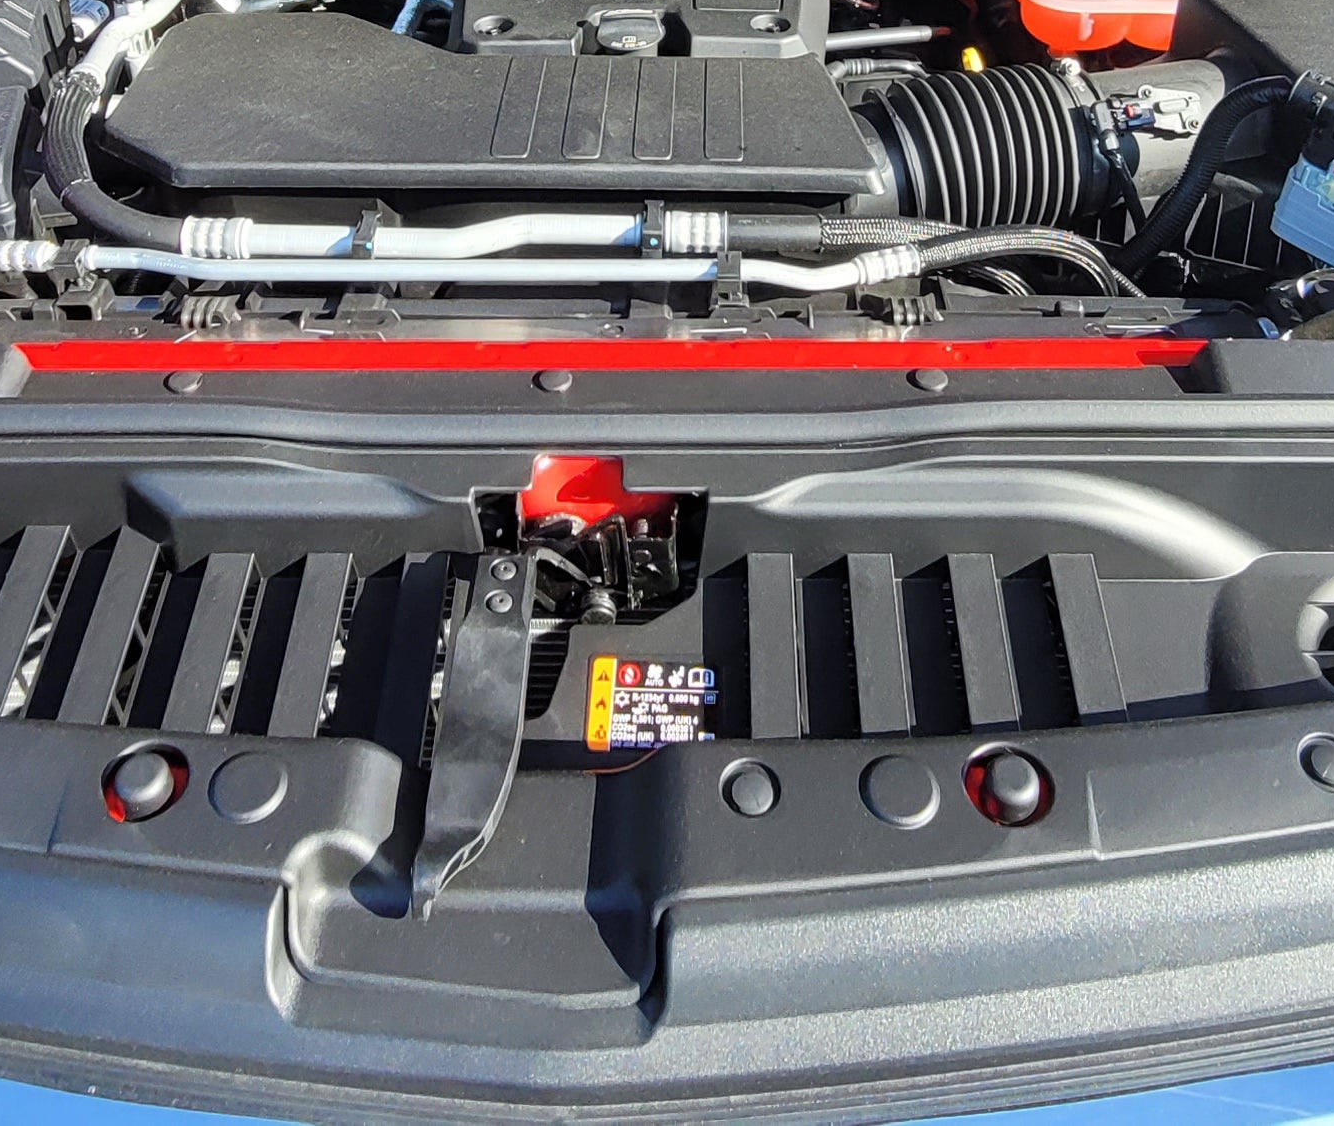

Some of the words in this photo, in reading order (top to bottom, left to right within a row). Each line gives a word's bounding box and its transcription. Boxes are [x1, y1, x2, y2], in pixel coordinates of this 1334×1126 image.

[644, 678, 664, 687] AUTO
[651, 703, 669, 713] PAG
[612, 714, 631, 723] GWP
[655, 715, 674, 725] GWP
